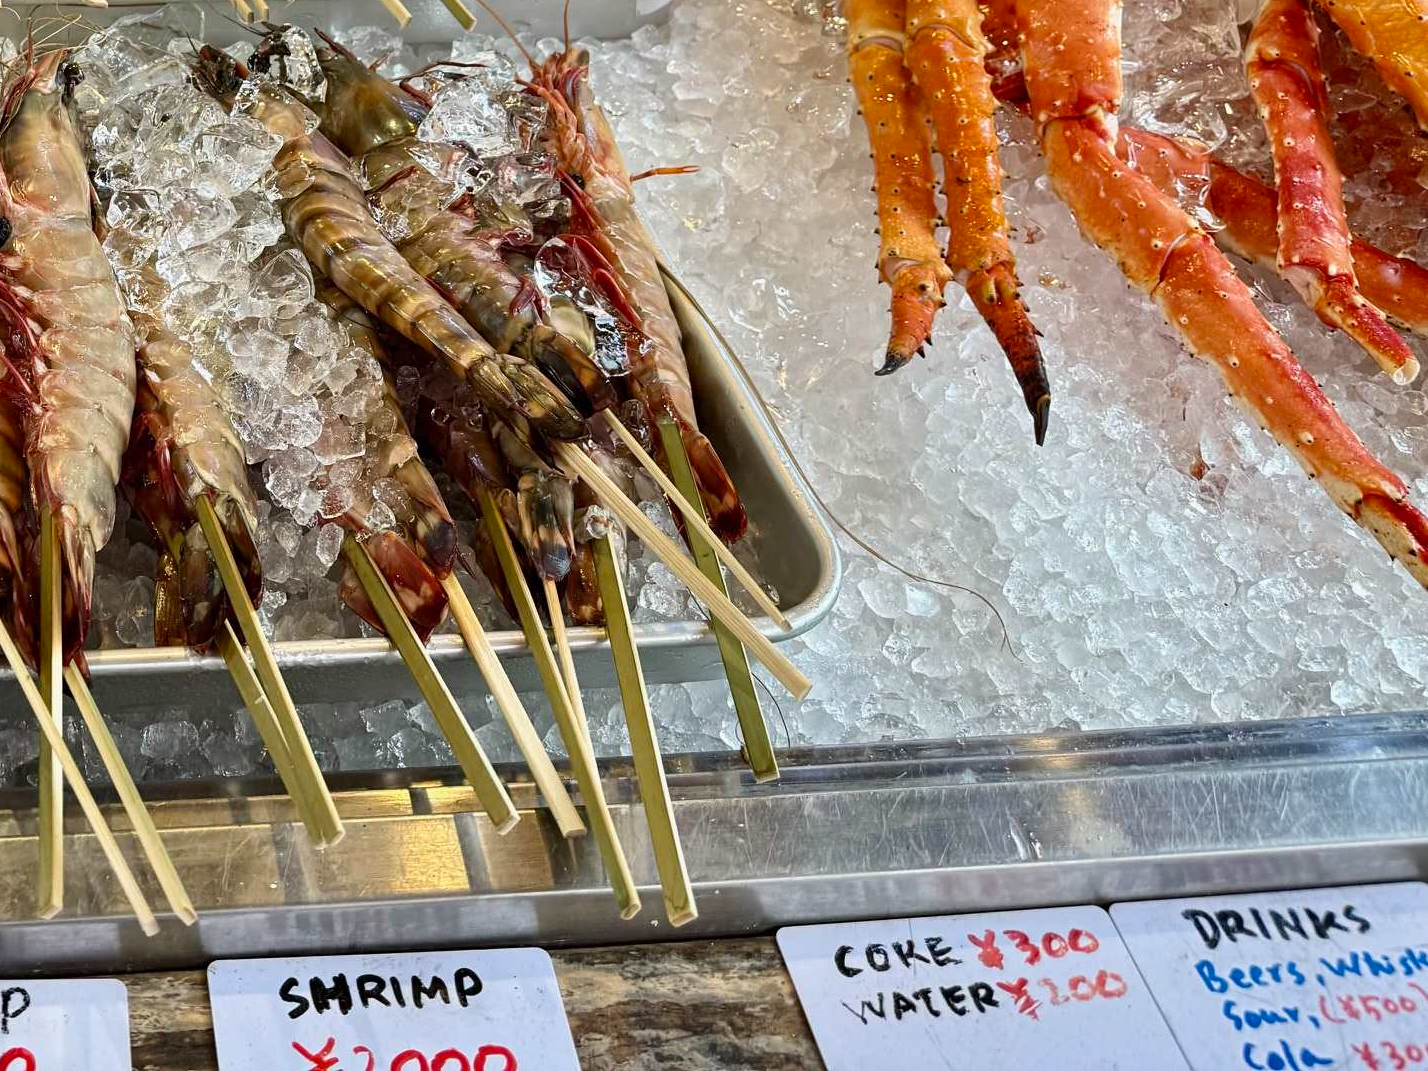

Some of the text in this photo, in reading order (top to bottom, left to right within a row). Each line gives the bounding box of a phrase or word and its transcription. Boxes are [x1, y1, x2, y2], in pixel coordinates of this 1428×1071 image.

[1180, 905, 1371, 949] DRINKS
[834, 928, 1100, 977] COKE ¥300
[279, 967, 483, 1019] SHRIMP
[841, 970, 1128, 1025] WATER ¥200
[1350, 1040, 1428, 1071] ¥30
